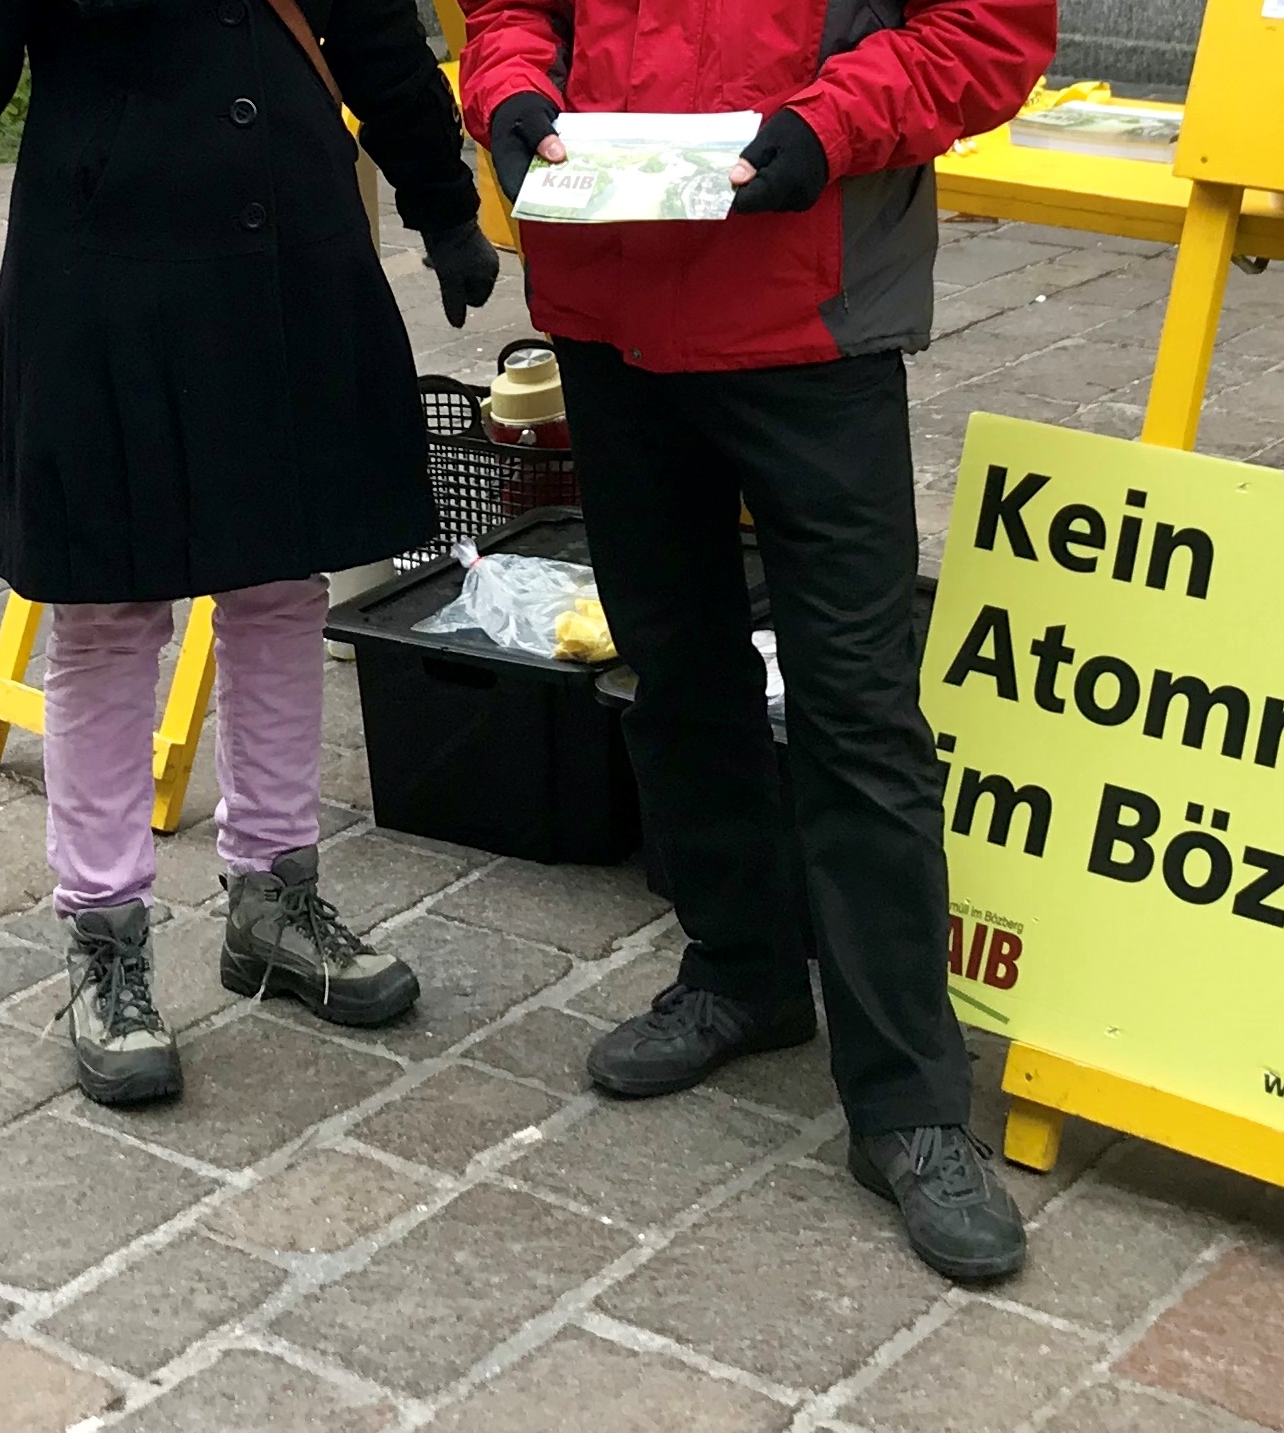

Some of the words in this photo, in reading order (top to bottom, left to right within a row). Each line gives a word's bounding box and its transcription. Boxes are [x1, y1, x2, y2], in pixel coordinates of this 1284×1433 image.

[542, 171, 595, 190] KAIB
[973, 464, 1215, 600] Kein
[930, 732, 1053, 858] im
[948, 913, 1023, 990] AIB
[950, 901, 970, 915] müll
[971, 906, 983, 920] im
[984, 910, 1024, 935] Bözberg
